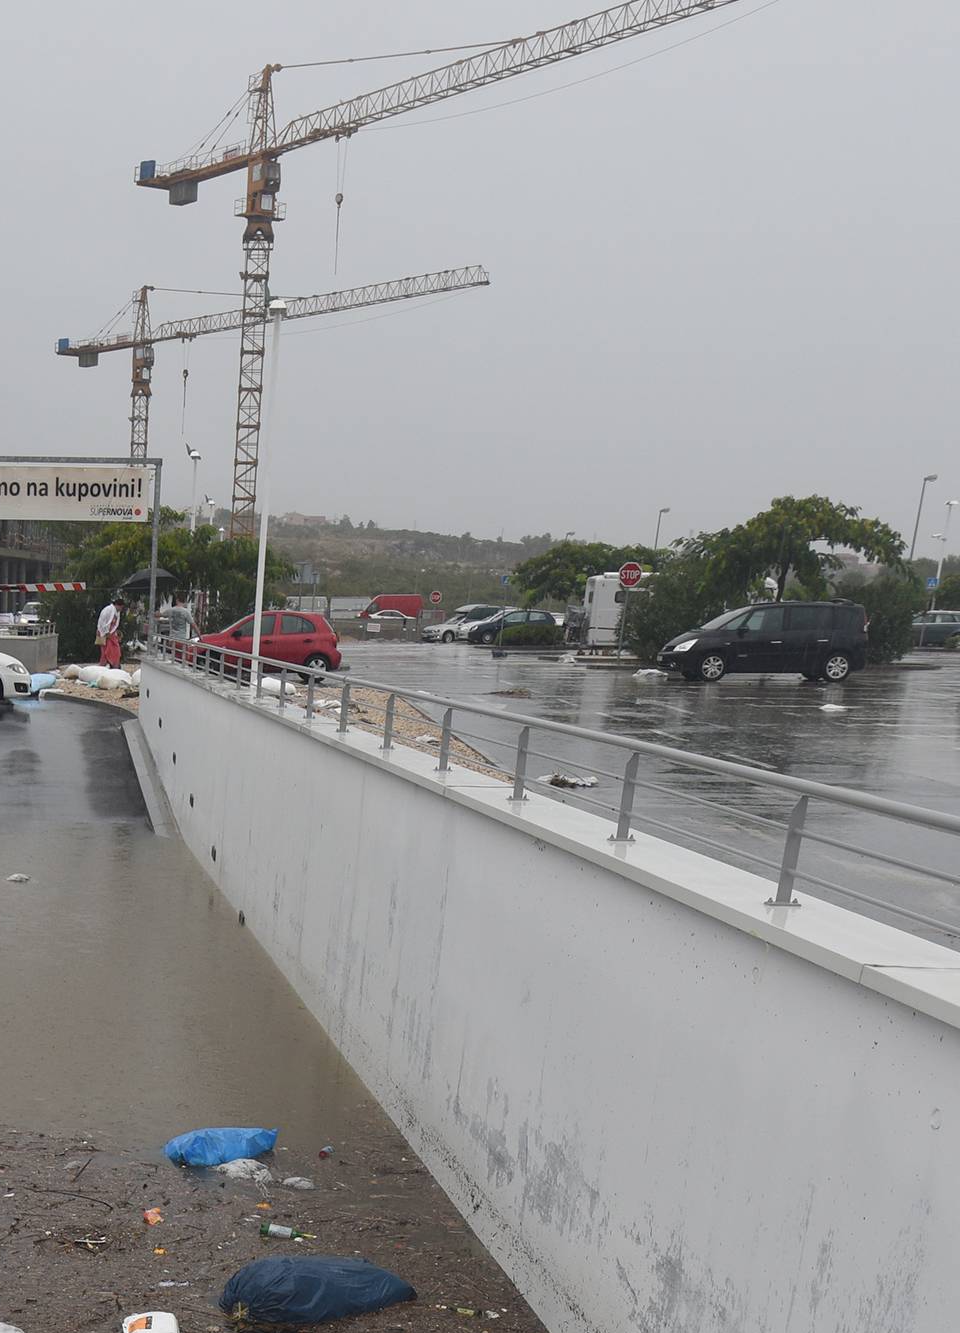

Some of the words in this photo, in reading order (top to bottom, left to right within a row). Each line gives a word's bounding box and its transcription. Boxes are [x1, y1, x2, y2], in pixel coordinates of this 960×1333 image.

[26, 480, 48, 497] na
[55, 477, 142, 501] kupovini!
[621, 569, 640, 580] STOP
